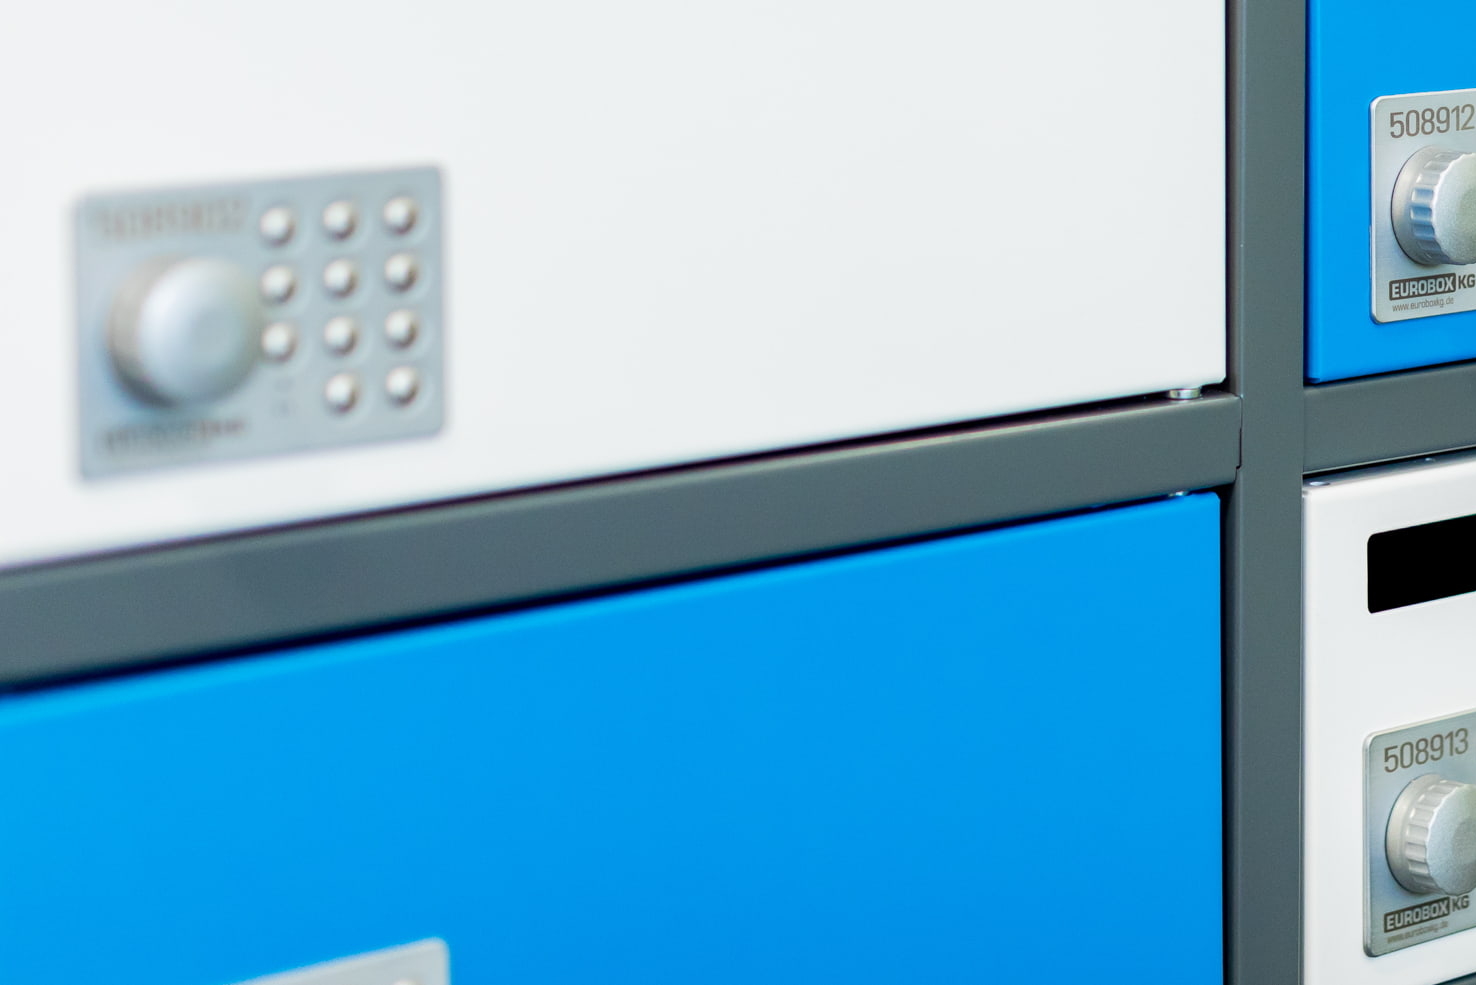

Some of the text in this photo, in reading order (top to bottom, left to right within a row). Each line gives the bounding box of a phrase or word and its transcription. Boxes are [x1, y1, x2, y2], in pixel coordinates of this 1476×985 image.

[1389, 103, 1475, 139] 508912
[1391, 273, 1476, 298] EUROBOX KG
[1392, 296, 1454, 312] www.euroboxkg.de
[1383, 727, 1468, 773] 508913
[1386, 895, 1470, 931] EUROBOX KG
